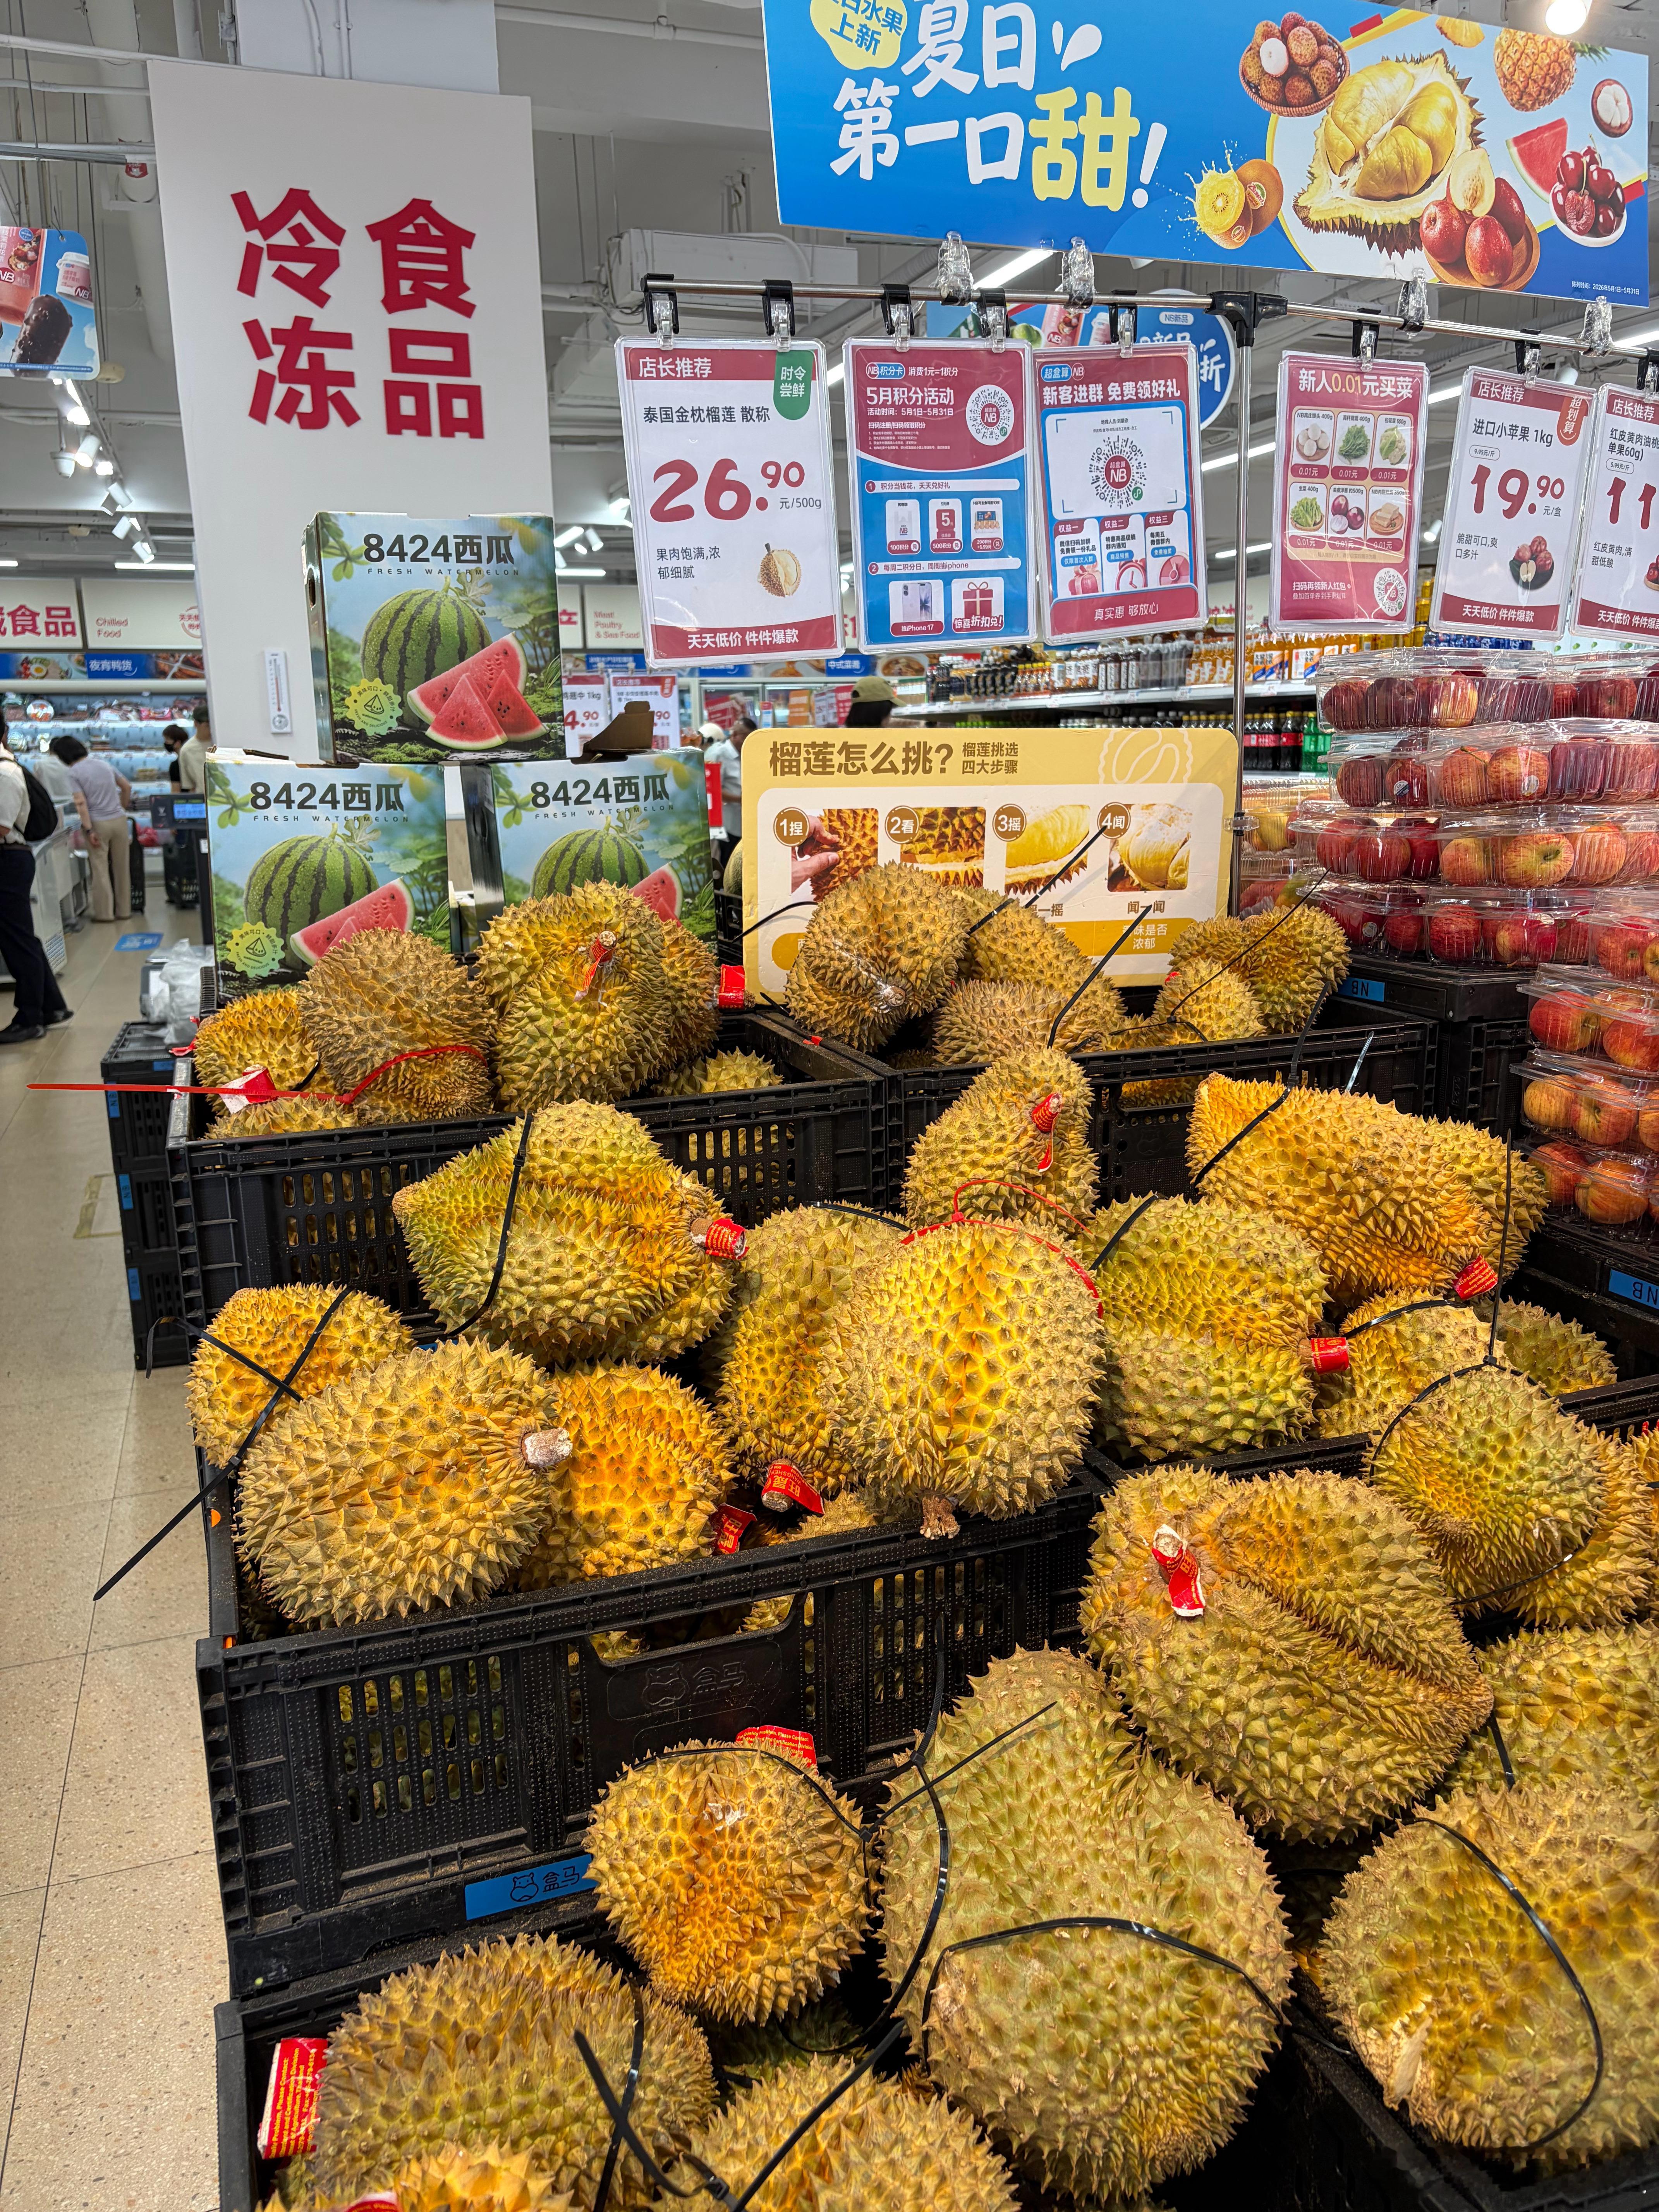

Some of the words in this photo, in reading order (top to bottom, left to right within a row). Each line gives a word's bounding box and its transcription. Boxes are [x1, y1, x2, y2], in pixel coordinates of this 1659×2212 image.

[830, 0, 903, 36] 日水果
[830, 12, 881, 56] 上新
[901, 0, 1037, 98] 夏日
[76, 288, 89, 299] NB
[1048, 333, 1061, 344] NB
[639, 357, 712, 378] 店长推荐
[780, 366, 806, 381] 时令
[867, 366, 878, 375] NB
[880, 366, 903, 376] 积分卡
[1044, 368, 1069, 379] 超盒算
[1073, 366, 1084, 376] NB
[1200, 354, 1226, 392] 折
[780, 383, 805, 398] 尝鲜
[867, 387, 954, 405] 5月积分活动
[1043, 383, 1103, 405] 新客进群
[1108, 378, 1180, 402] 免费领好礼
[1478, 381, 1525, 403] 店长推荐
[643, 406, 736, 424] 泰国金枕榴莲
[740, 406, 770, 422] 散称
[1563, 397, 1582, 434] 超划算
[1613, 398, 1655, 421] 店长推荐
[984, 413, 997, 423] NB
[1472, 418, 1530, 442] 进口小苹果
[1534, 429, 1553, 447] 1kg
[1474, 449, 1496, 458] 9.95元/斤
[1299, 468, 1318, 476] 0.01元
[1339, 470, 1358, 478] 0.01元
[1611, 462, 1630, 471] 5.95元/斤
[1110, 469, 1127, 483] NB
[1378, 472, 1397, 480] 0.01元
[649, 458, 805, 522] 26.90
[1470, 464, 1565, 519] 19.90
[779, 498, 821, 509] 元/500g
[1543, 506, 1562, 517] 元/盒
[941, 512, 950, 526] 5
[1104, 520, 1124, 529] 权益二
[1149, 515, 1168, 524] 权益三
[1059, 524, 1079, 532] 权益一
[364, 533, 514, 565] 8424西瓜
[1297, 539, 1316, 547] 0.01元
[1455, 549, 1479, 561] 口多汁
[1591, 556, 1614, 568] 甜低酸
[658, 565, 694, 580] 郁细腻
[1094, 606, 1125, 621] 真实惠
[1128, 602, 1159, 617] 够放心
[1462, 604, 1497, 620] 天天低价
[1499, 607, 1534, 623] 件件爆款
[1597, 610, 1631, 626] 天天低价
[0, 604, 77, 638] 食品
[96, 617, 129, 627] Chilled
[97, 629, 122, 638] Food
[687, 632, 742, 649] 天天低价
[745, 628, 799, 646] 件件爆款
[962, 742, 1018, 757] 榴莲挑选
[769, 741, 953, 776] 榴莲怎么挑?
[962, 759, 1018, 774] 四大步骤
[250, 782, 404, 812] 8424西瓜
[531, 773, 670, 809] 8424西瓜
[535, 811, 576, 820] FRESH
[588, 804, 674, 816] WATERMELON
[780, 819, 804, 836] 1捏
[890, 817, 915, 835] 2看
[997, 815, 1021, 832] 3摇
[1101, 812, 1125, 830] 4闻
[1133, 938, 1155, 950] 浓郁
[1352, 980, 1369, 997] NB
[1633, 1281, 1658, 1305] NB
[693, 1661, 748, 1695] 盒马
[543, 1865, 580, 1893] 盒马
